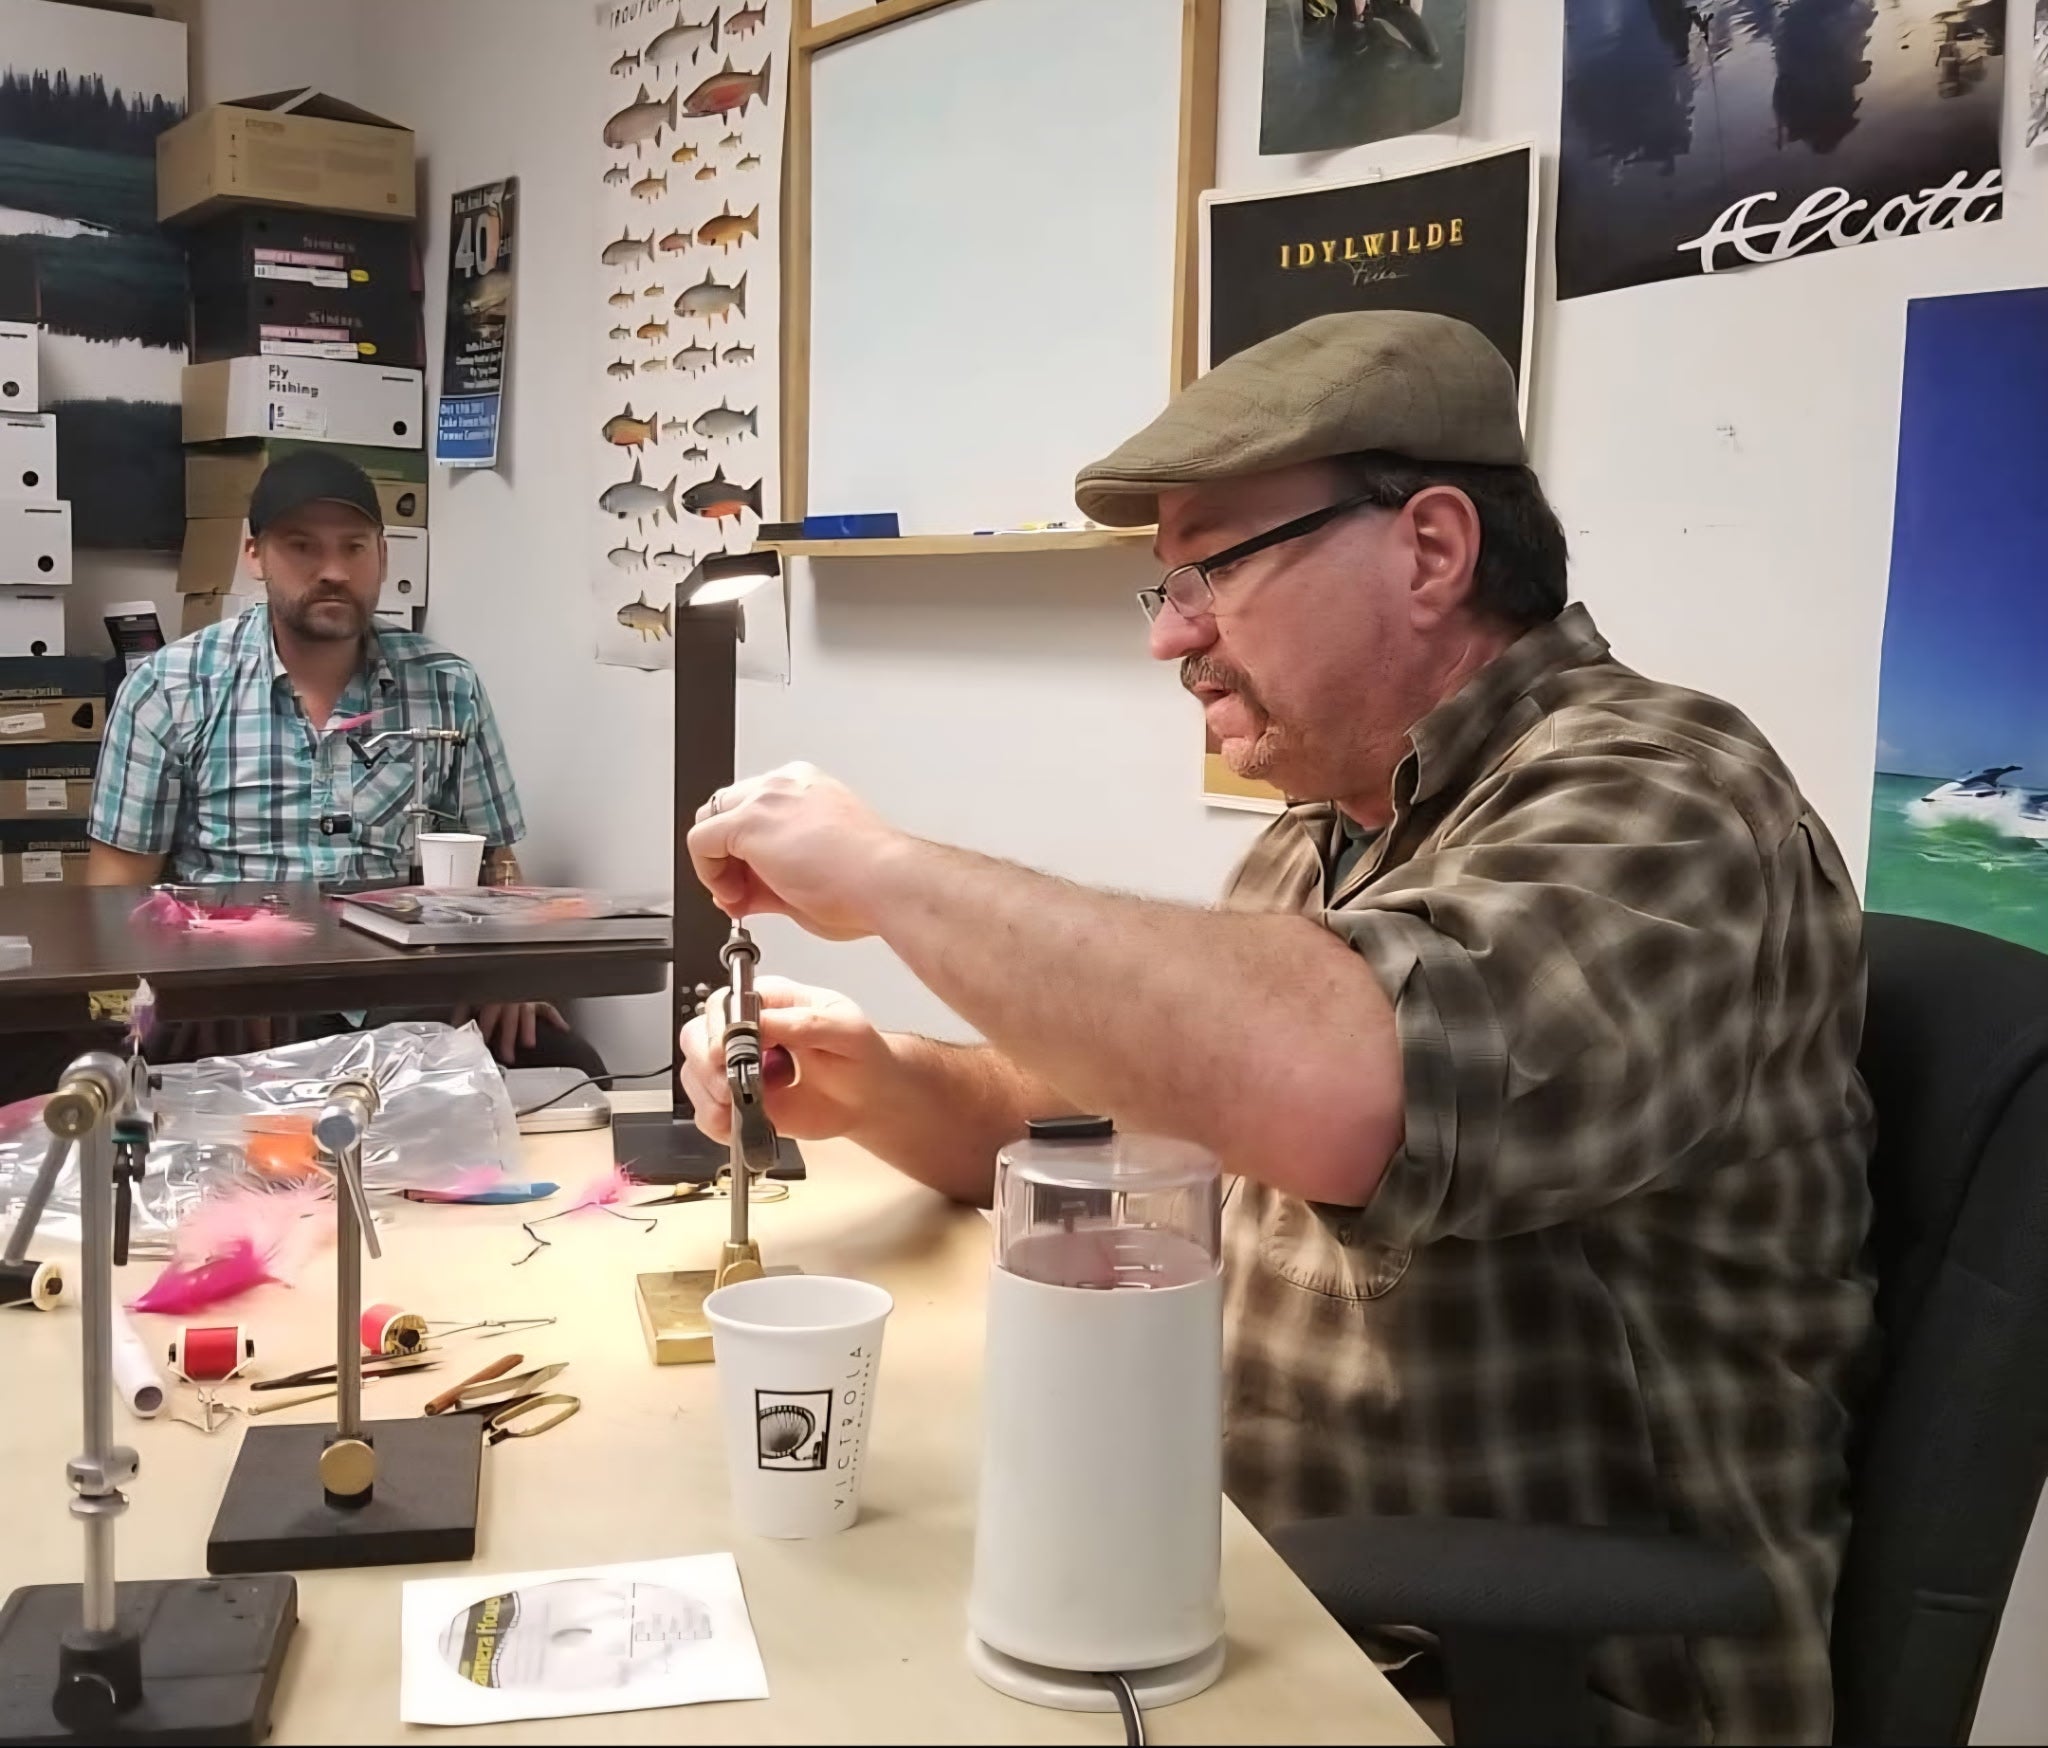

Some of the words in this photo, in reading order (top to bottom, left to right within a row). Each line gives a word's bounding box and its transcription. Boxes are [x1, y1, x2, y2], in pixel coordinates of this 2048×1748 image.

[454, 212, 501, 278] 40
[1280, 218, 1465, 269] IDYLWILDE
[1677, 168, 2004, 274] Alcott
[268, 364, 289, 380] Fly
[268, 380, 319, 398] Fishing
[834, 1346, 862, 1510] VICTROLA
[475, 1598, 500, 1634] Hous
[470, 1636, 496, 1687] amera
